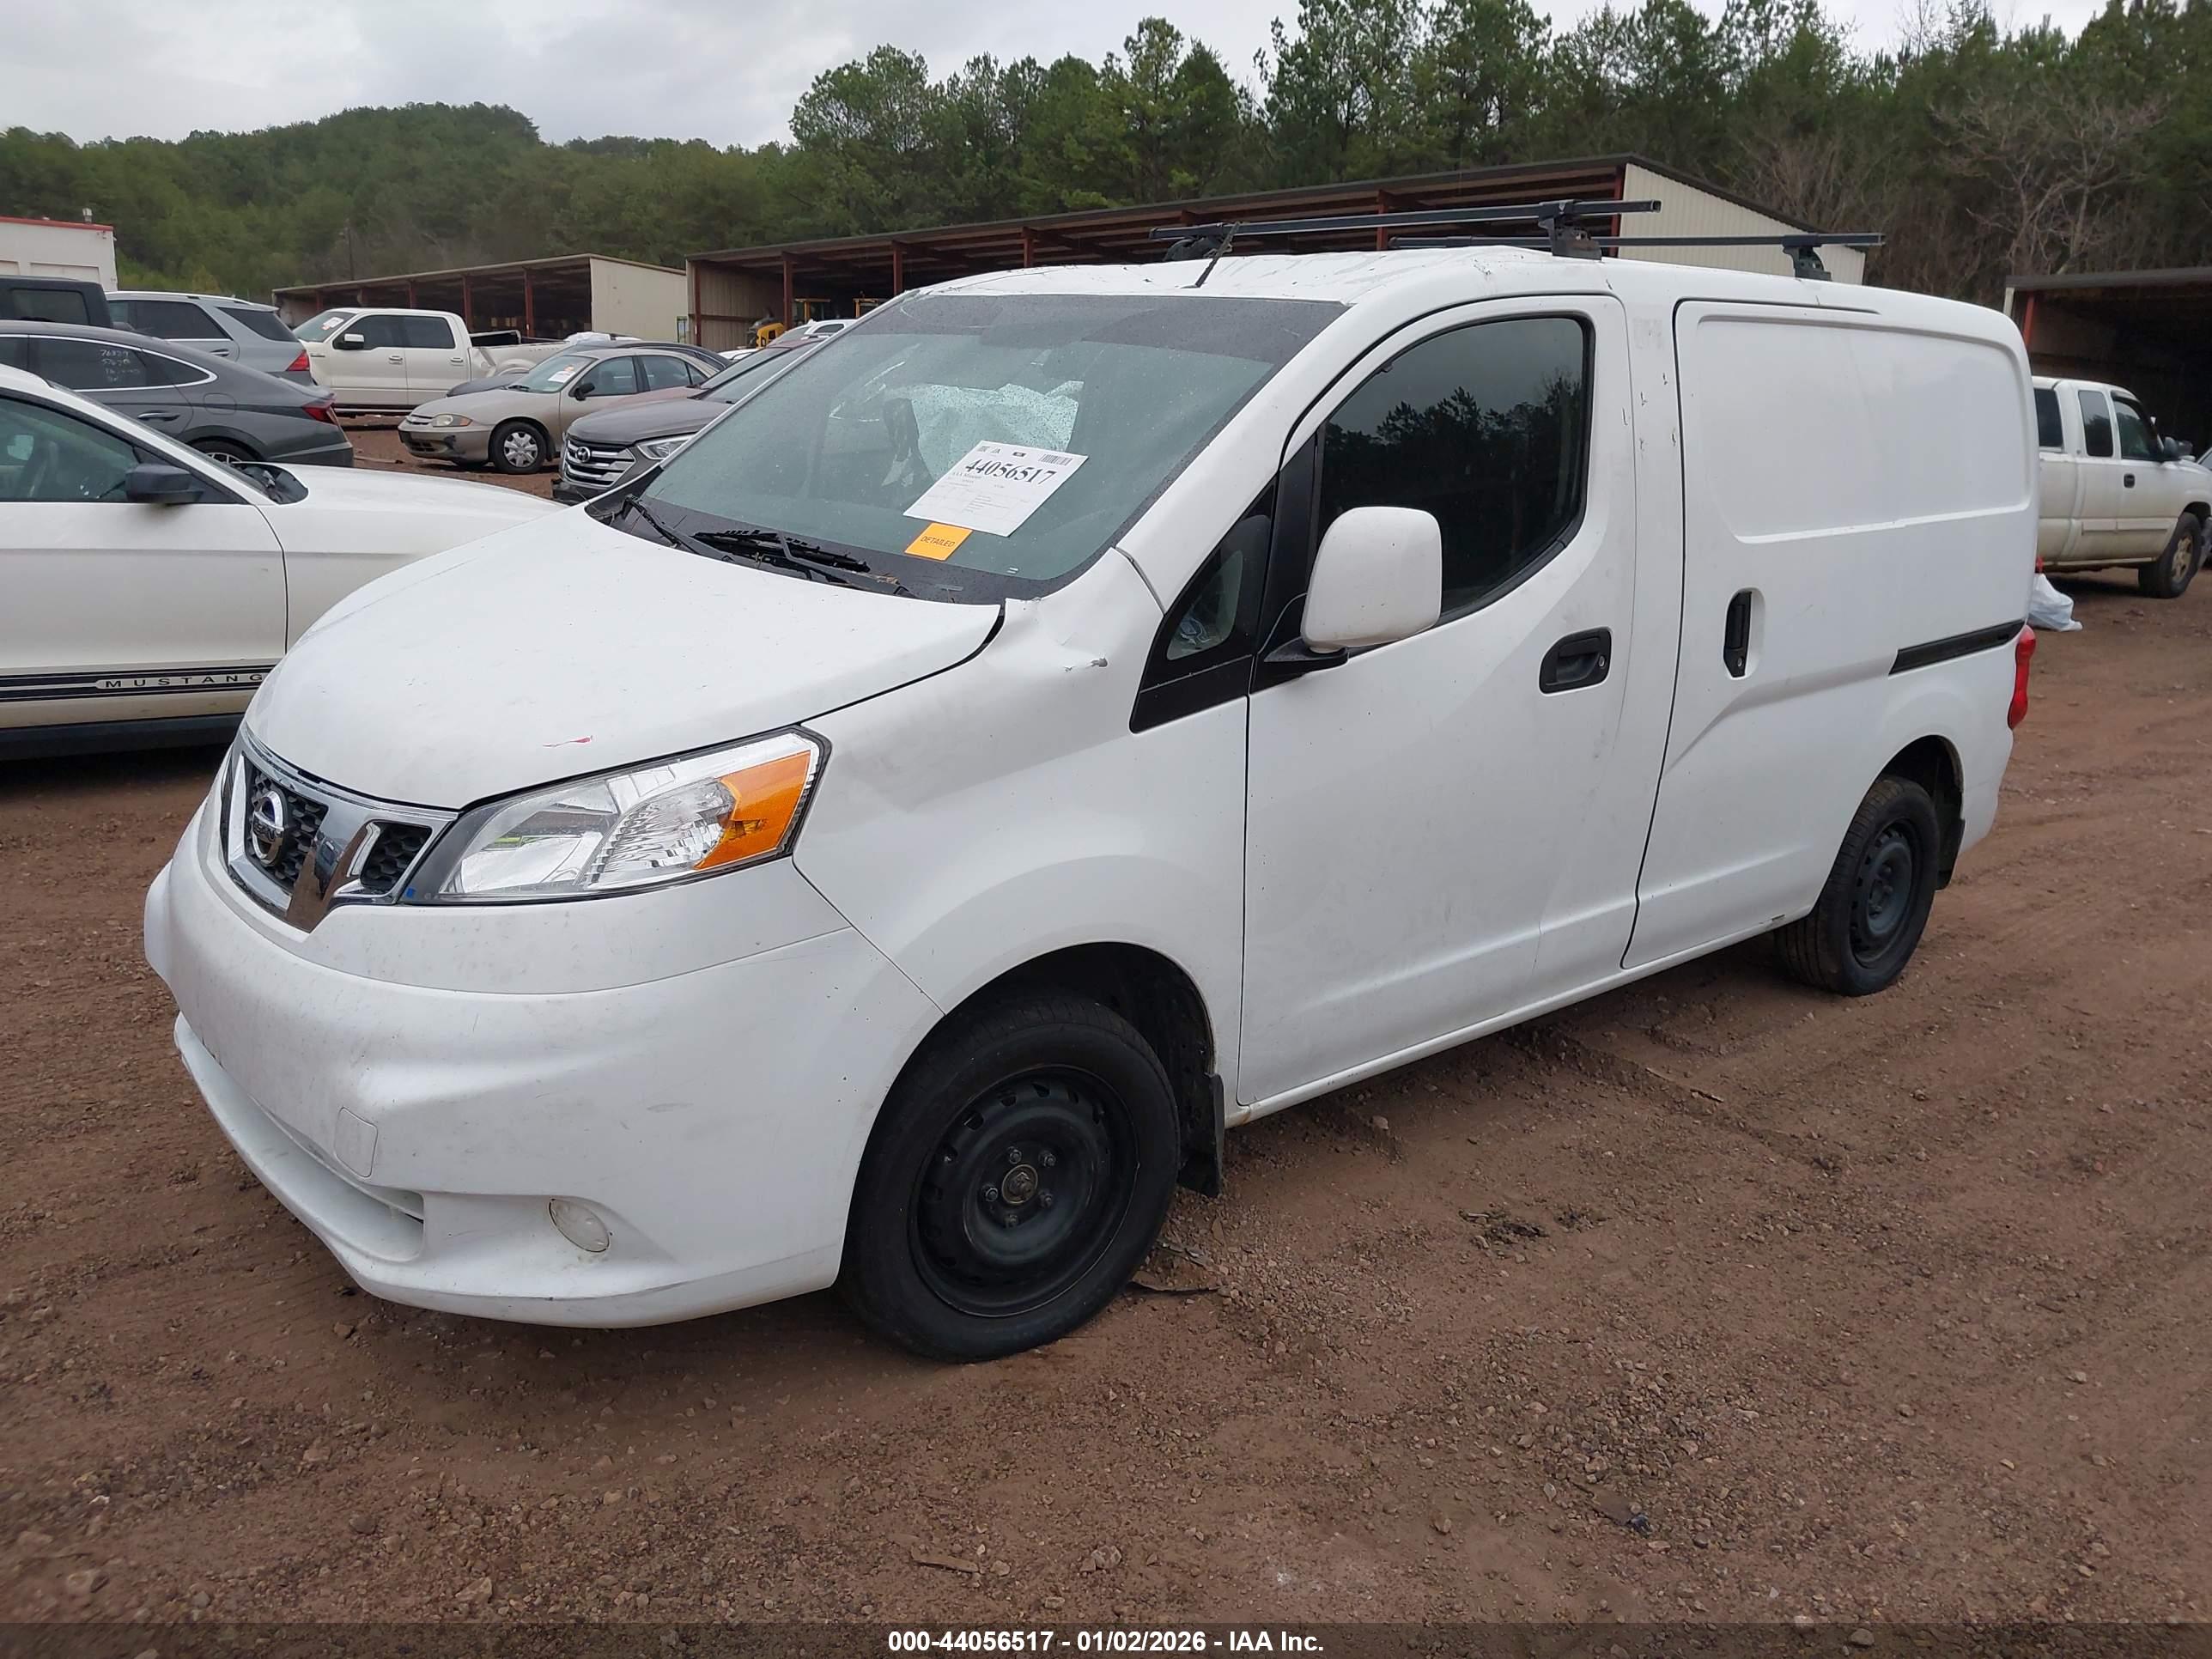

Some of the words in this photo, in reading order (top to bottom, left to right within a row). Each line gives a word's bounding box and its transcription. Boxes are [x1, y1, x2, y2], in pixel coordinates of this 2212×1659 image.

[965, 459, 1057, 485] 44056517
[920, 535, 956, 548] DETAILED
[105, 673, 263, 688] MUSTANG
